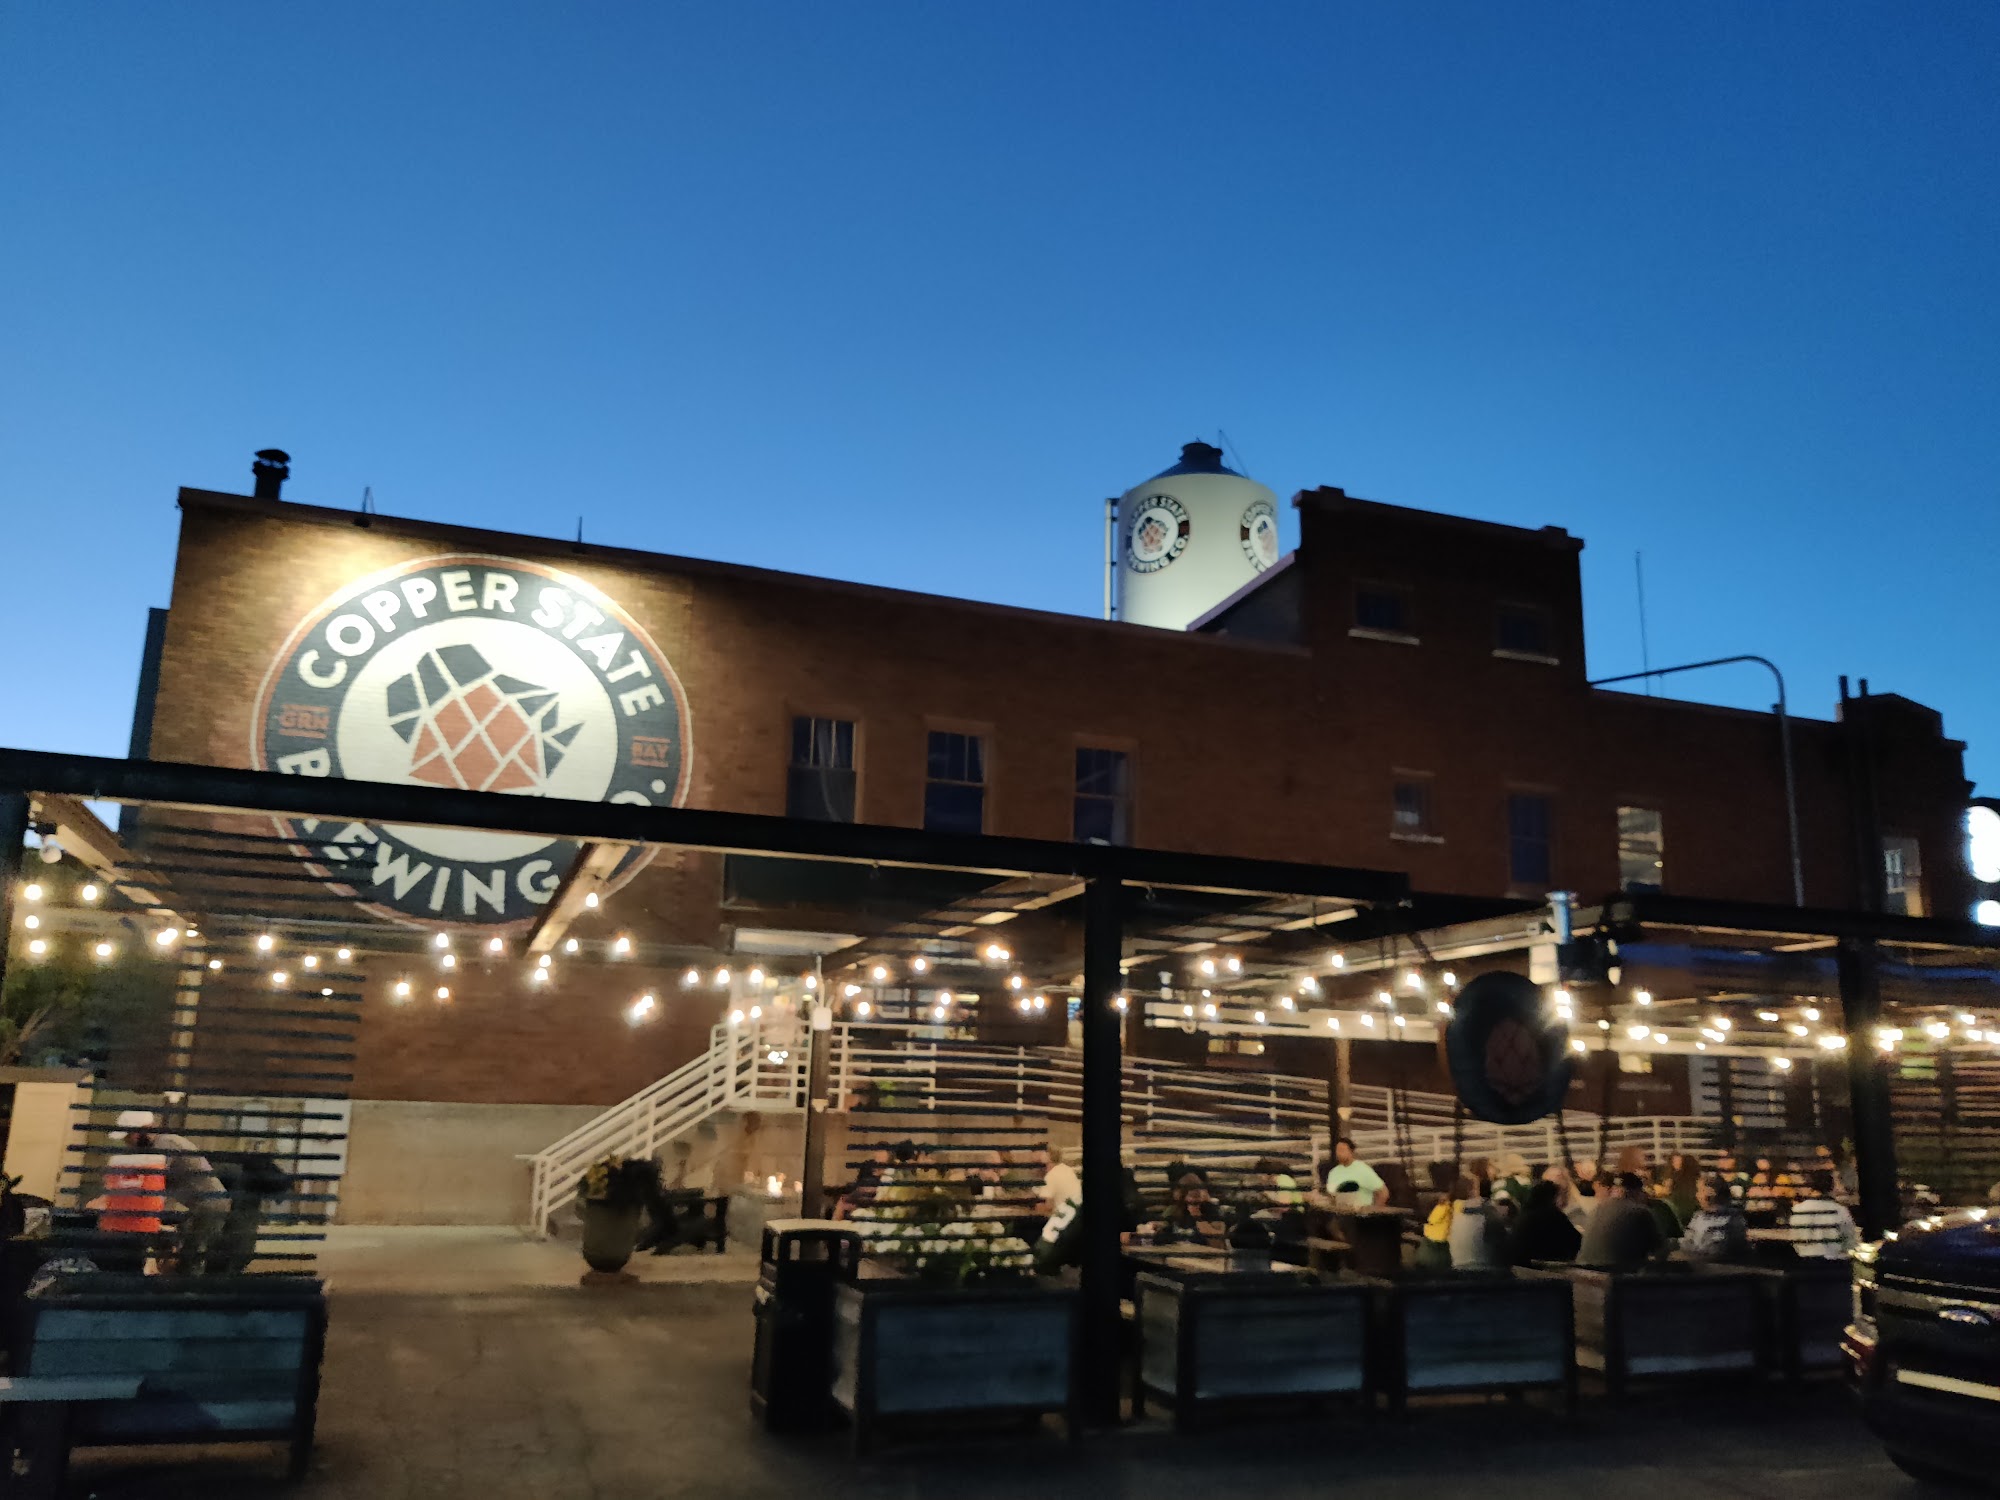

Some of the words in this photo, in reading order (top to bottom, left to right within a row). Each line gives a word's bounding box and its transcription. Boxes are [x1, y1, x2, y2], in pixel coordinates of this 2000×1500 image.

[297, 570, 520, 688] COPPER
[531, 586, 665, 716] STATE
[632, 742, 669, 761] BAY
[276, 747, 561, 915] BEWING
